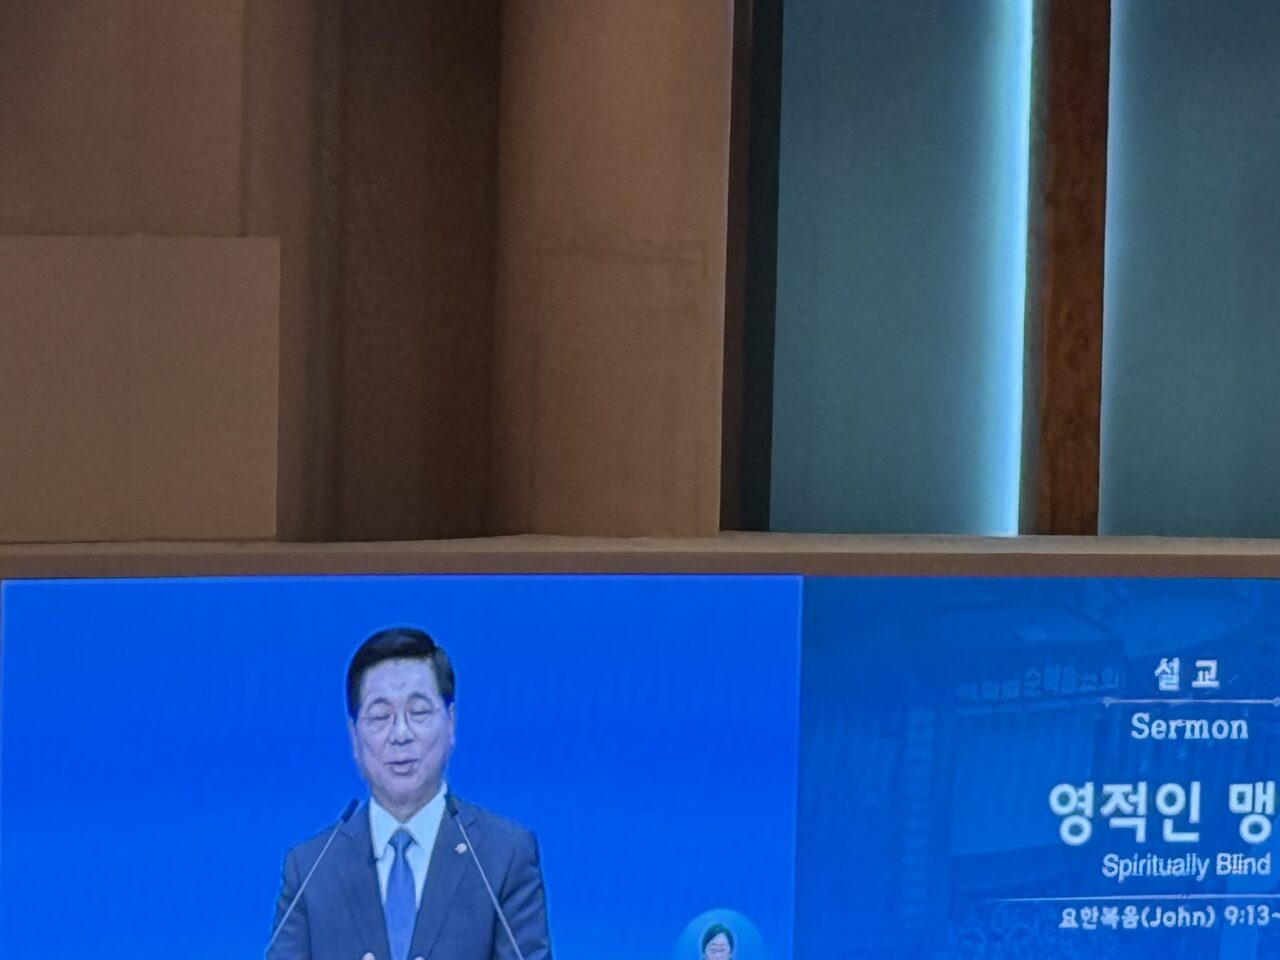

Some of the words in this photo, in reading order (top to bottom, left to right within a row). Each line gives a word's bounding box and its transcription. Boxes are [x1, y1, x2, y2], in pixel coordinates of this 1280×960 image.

[1131, 712, 1248, 740] Sermon
[1049, 781, 1200, 846] 영적인
[1102, 852, 1210, 882] Spiritually
[1216, 851, 1272, 876] Blind
